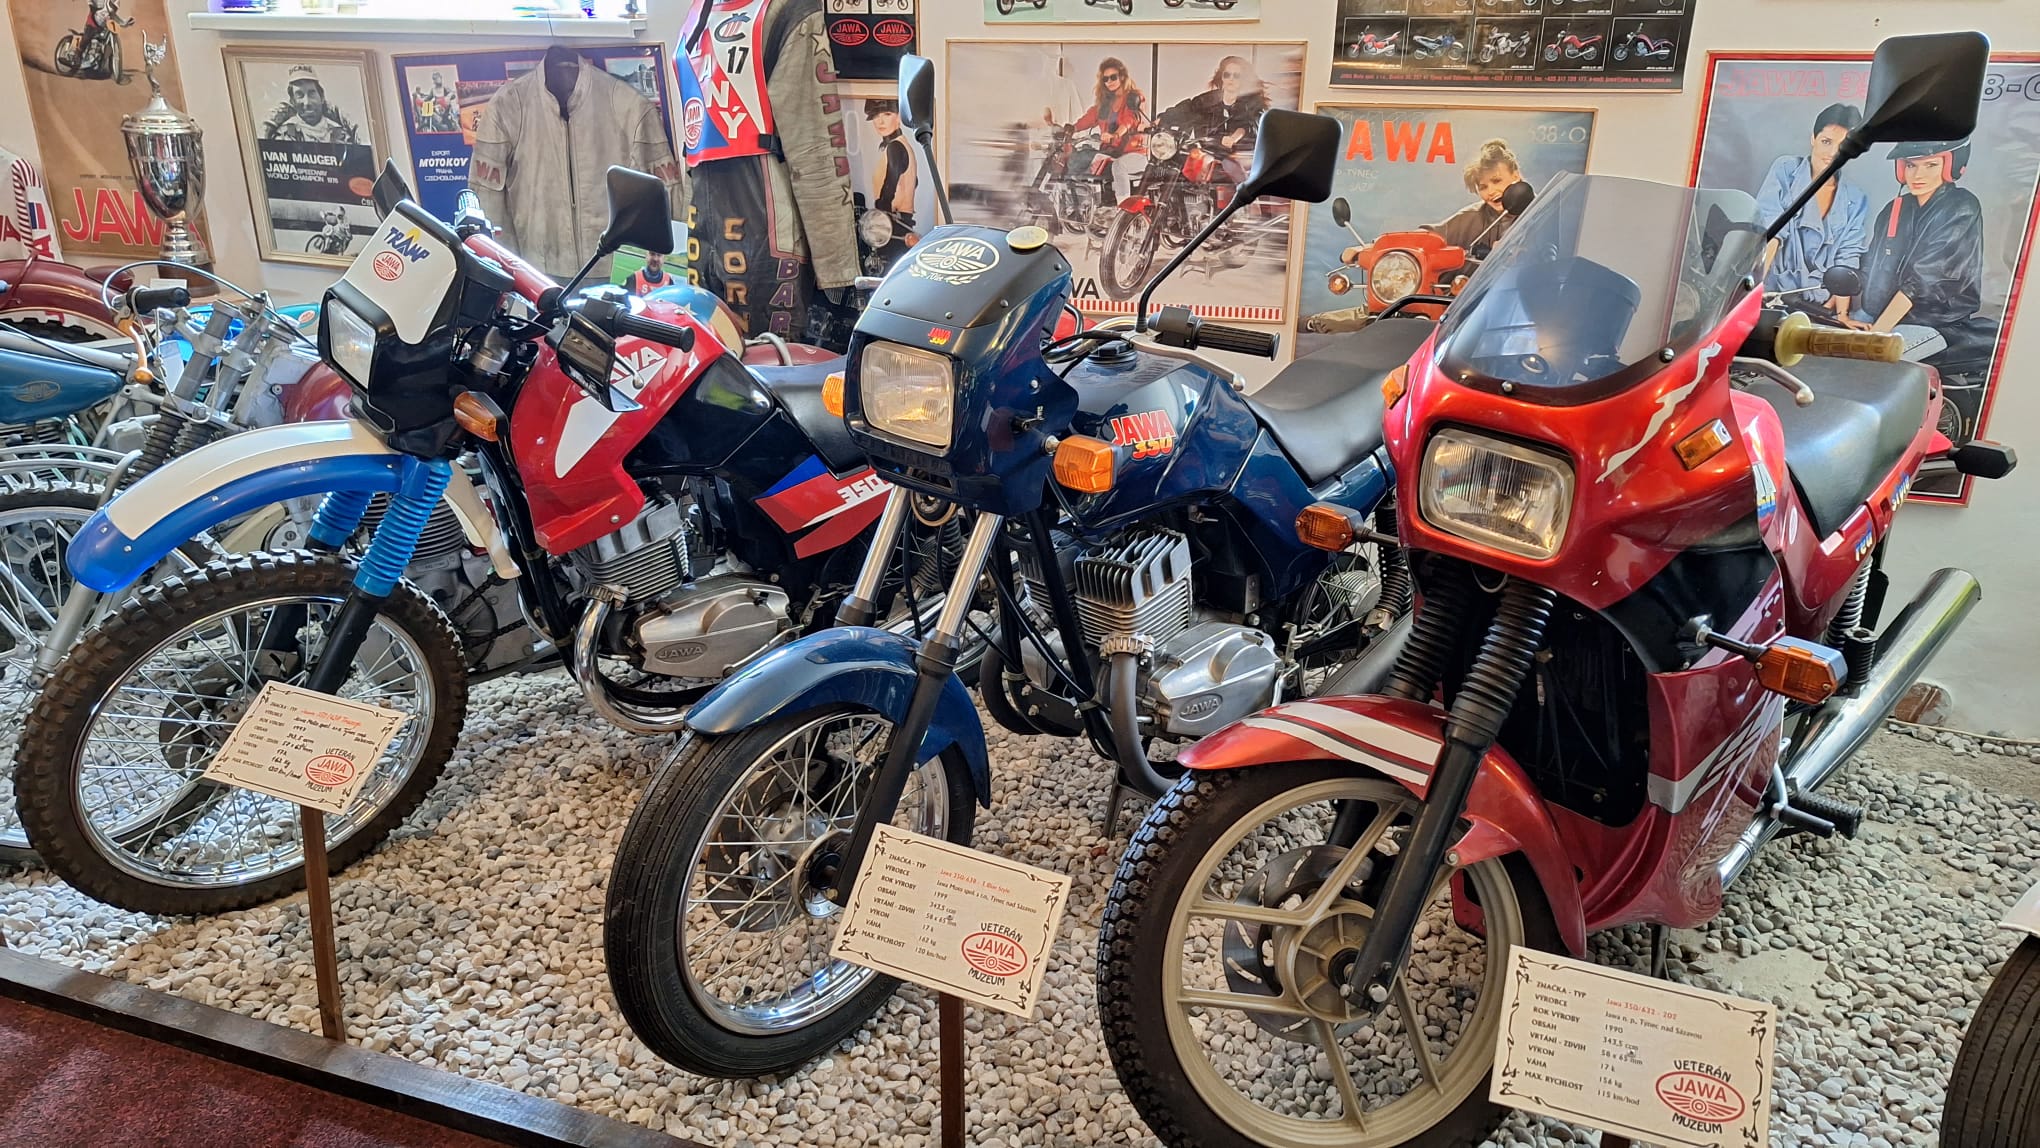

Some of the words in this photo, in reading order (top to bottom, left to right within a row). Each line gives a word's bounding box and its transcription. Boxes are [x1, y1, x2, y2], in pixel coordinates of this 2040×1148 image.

[837, 24, 861, 33] JAWA
[881, 24, 905, 33] JAWA
[727, 46, 749, 74] 17
[1719, 70, 1825, 98] JAWA
[262, 151, 288, 162] IVAN
[419, 157, 469, 168] MOTOKOV
[266, 163, 297, 174] JAWA
[297, 168, 328, 177] SPEEDWAY
[267, 172, 290, 180] WORLD
[292, 173, 325, 183] CHAMPION
[384, 226, 431, 263] TRAMP
[936, 241, 986, 260] JAWA
[381, 254, 401, 272] JAWA
[928, 327, 953, 341] JAWA
[1110, 410, 1177, 447] JAWA
[1132, 436, 1174, 460] 350
[836, 473, 894, 504] 350
[659, 646, 704, 659] JAWA
[1181, 698, 1219, 715] JAWA
[317, 759, 347, 774] JAWA
[305, 781, 333, 793] MUZEUM
[916, 861, 927, 869] TYP
[881, 875, 893, 884] ROK
[878, 886, 897, 896] OBSAH
[898, 904, 915, 915] ZDVIH
[1006, 900, 1016, 908] nad
[980, 922, 1023, 942] VETERÁN
[877, 934, 906, 948] RYCHLOST
[915, 946, 926, 955] 120
[975, 937, 1015, 959] JAWA
[967, 967, 1006, 986] MUZEUM
[1536, 981, 1567, 994] ZNAČKA
[1574, 990, 1587, 999] TYP
[1606, 998, 1622, 1008] Jawa
[1533, 1006, 1549, 1016] ROK
[1605, 1023, 1624, 1034] 1990
[1605, 1011, 1621, 1021] Jawa
[1660, 1024, 1674, 1033] nad
[1531, 1018, 1557, 1030] OBSAH
[1602, 1036, 1623, 1047] 343,5
[1563, 1040, 1586, 1052] ZDVIH
[1600, 1063, 1609, 1071] 17
[1673, 1059, 1732, 1083] VETERÁN
[1545, 1075, 1584, 1092] RYCHLOST
[1597, 1089, 1611, 1099] 115
[1612, 1092, 1640, 1106] km/hod
[1614, 1079, 1622, 1089] kg
[1673, 1077, 1728, 1103] JAWA
[1671, 1112, 1723, 1135] MUZEUM
